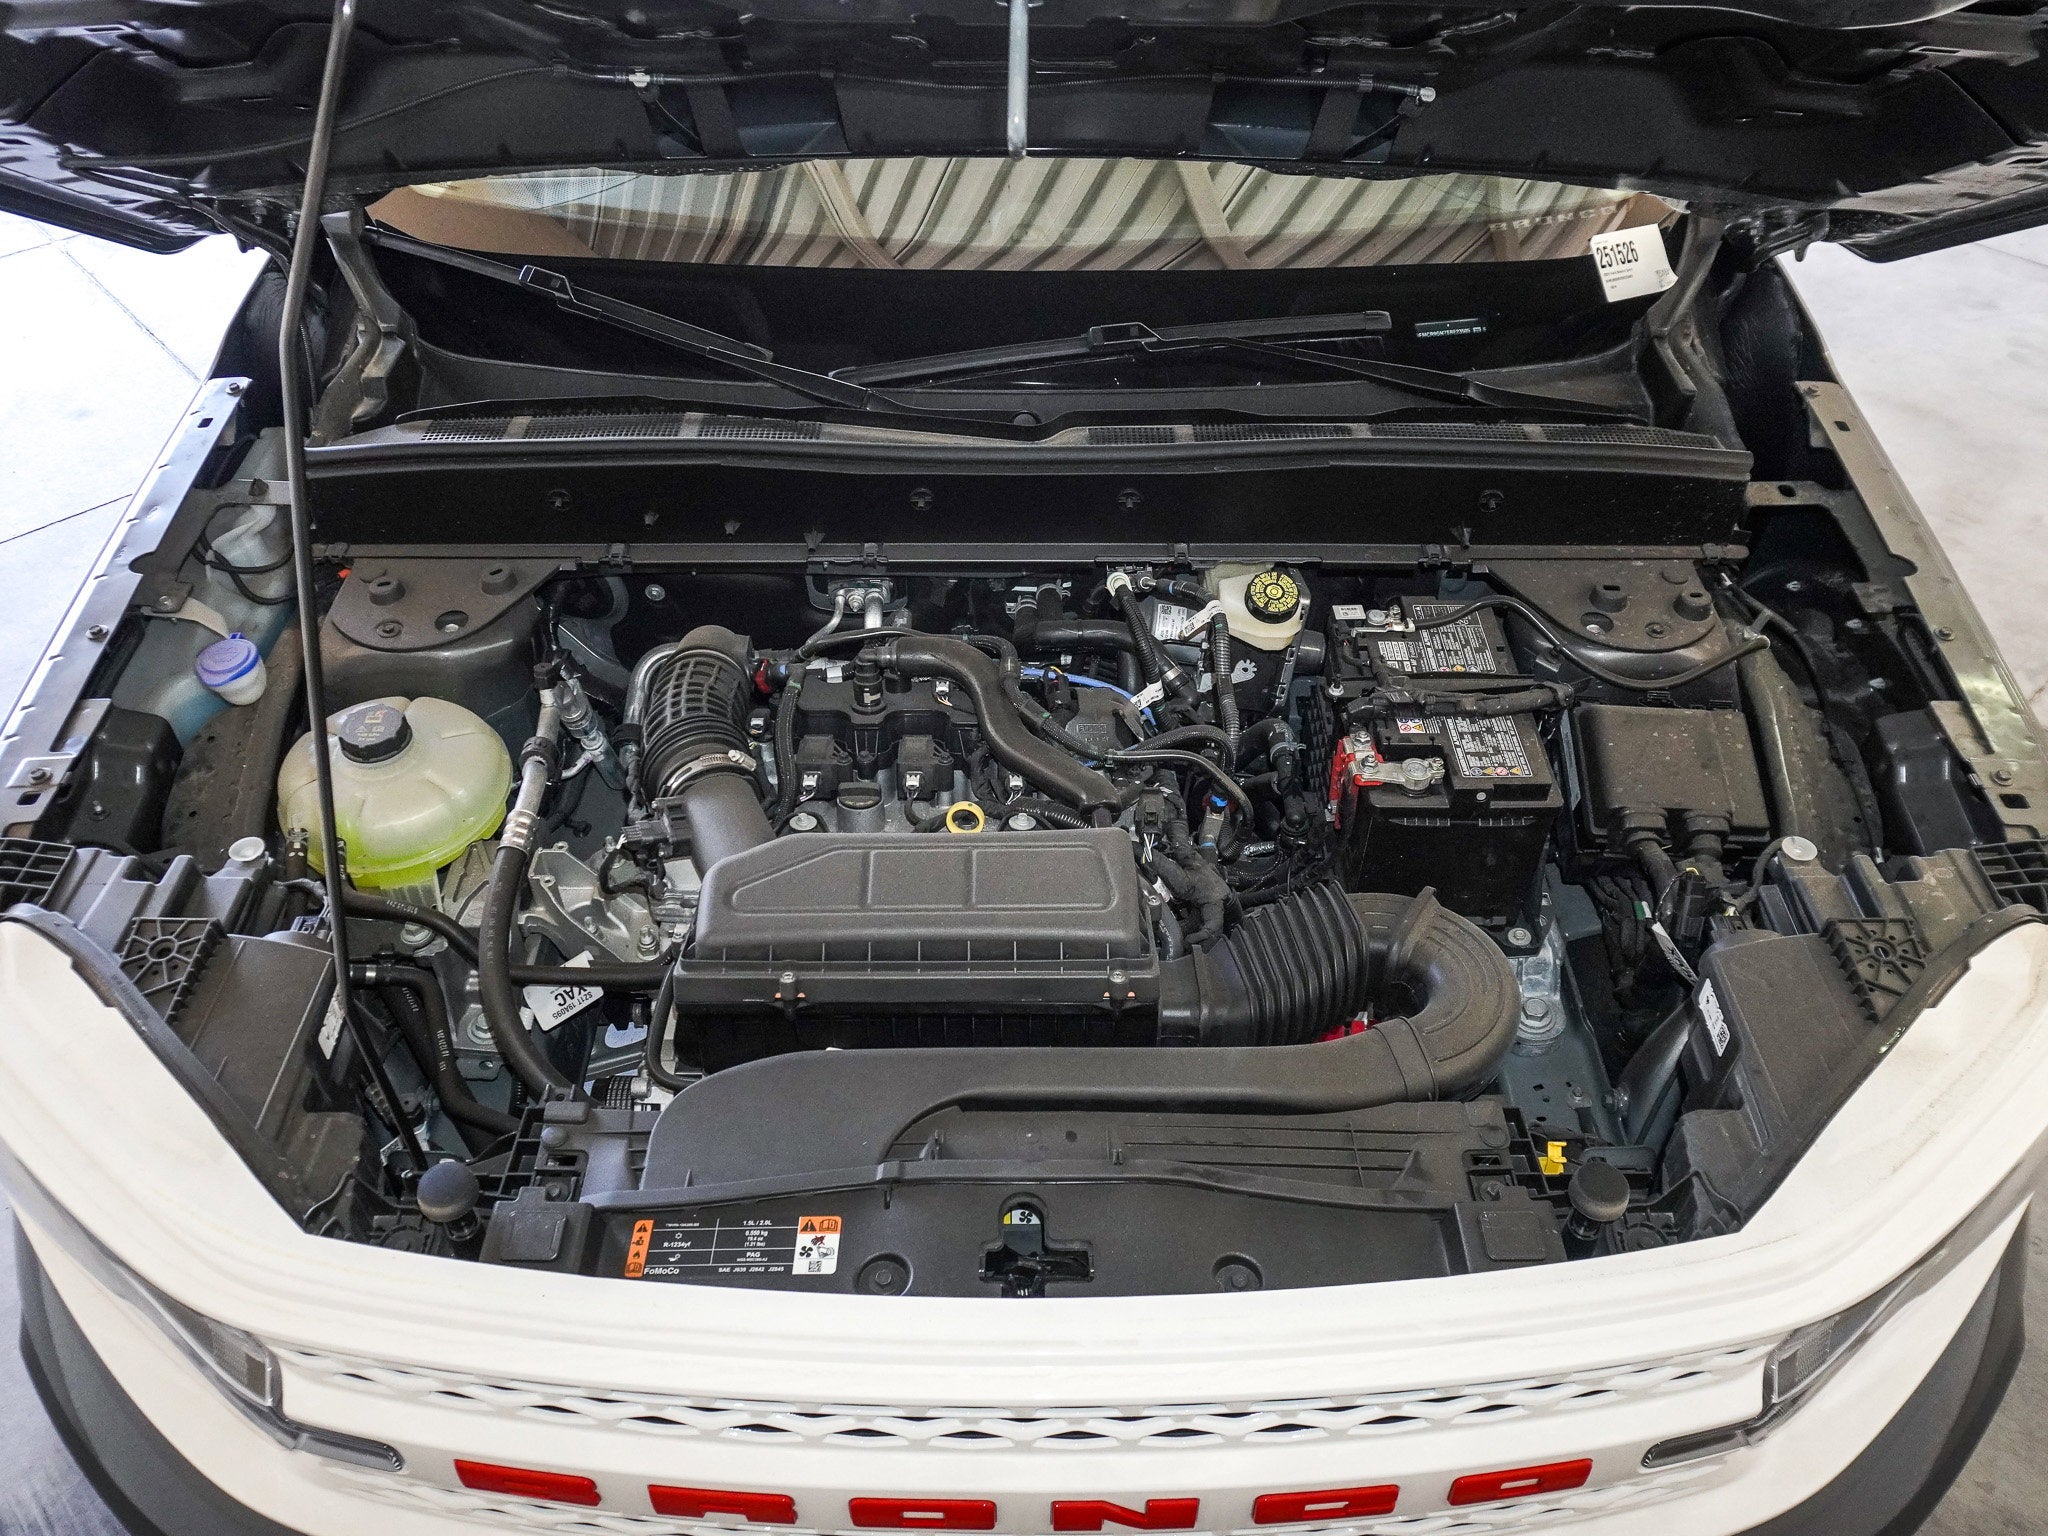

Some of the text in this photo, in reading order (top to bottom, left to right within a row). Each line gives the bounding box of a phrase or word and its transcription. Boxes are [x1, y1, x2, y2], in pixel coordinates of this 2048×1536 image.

[1596, 240, 1639, 269] 251526
[662, 1241, 692, 1249] R-1234yf
[643, 1267, 680, 1275] FoMoCo
[454, 1458, 1594, 1532] BRONCO
